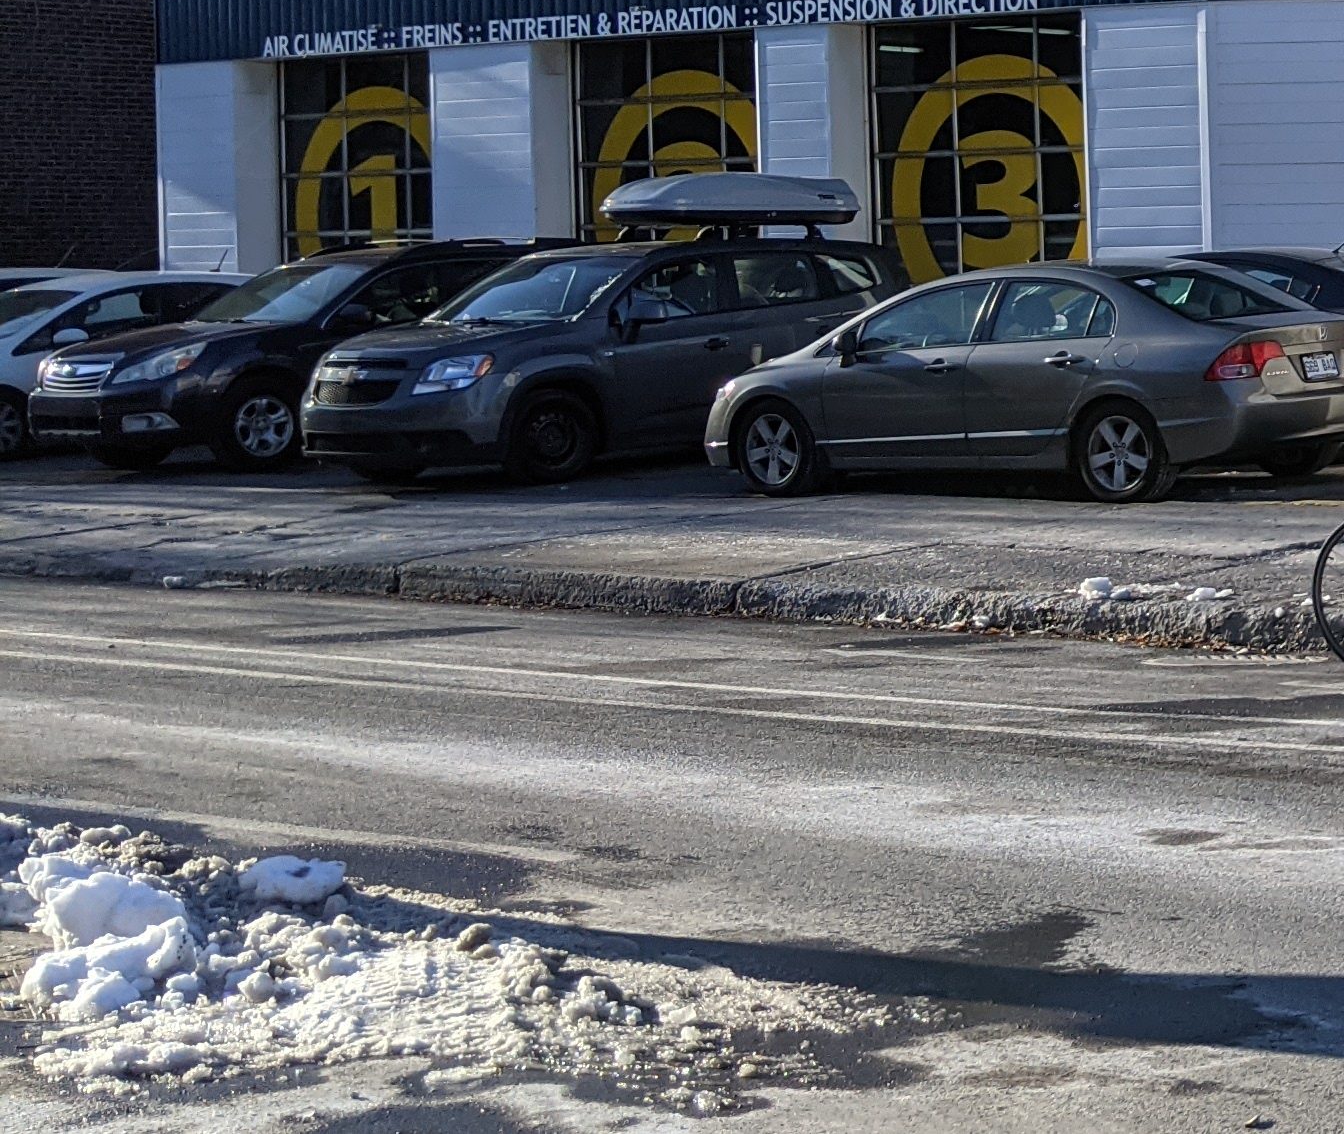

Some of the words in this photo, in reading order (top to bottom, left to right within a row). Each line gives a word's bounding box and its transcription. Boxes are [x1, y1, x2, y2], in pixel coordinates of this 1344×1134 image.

[263, 35, 289, 57] AIR
[402, 22, 463, 47] FREINS
[488, 14, 591, 42] ENTRETIEN
[596, 12, 611, 36] &
[617, 5, 737, 35] RÉPARATION
[348, 154, 397, 240] 1
[959, 129, 1040, 270] 3
